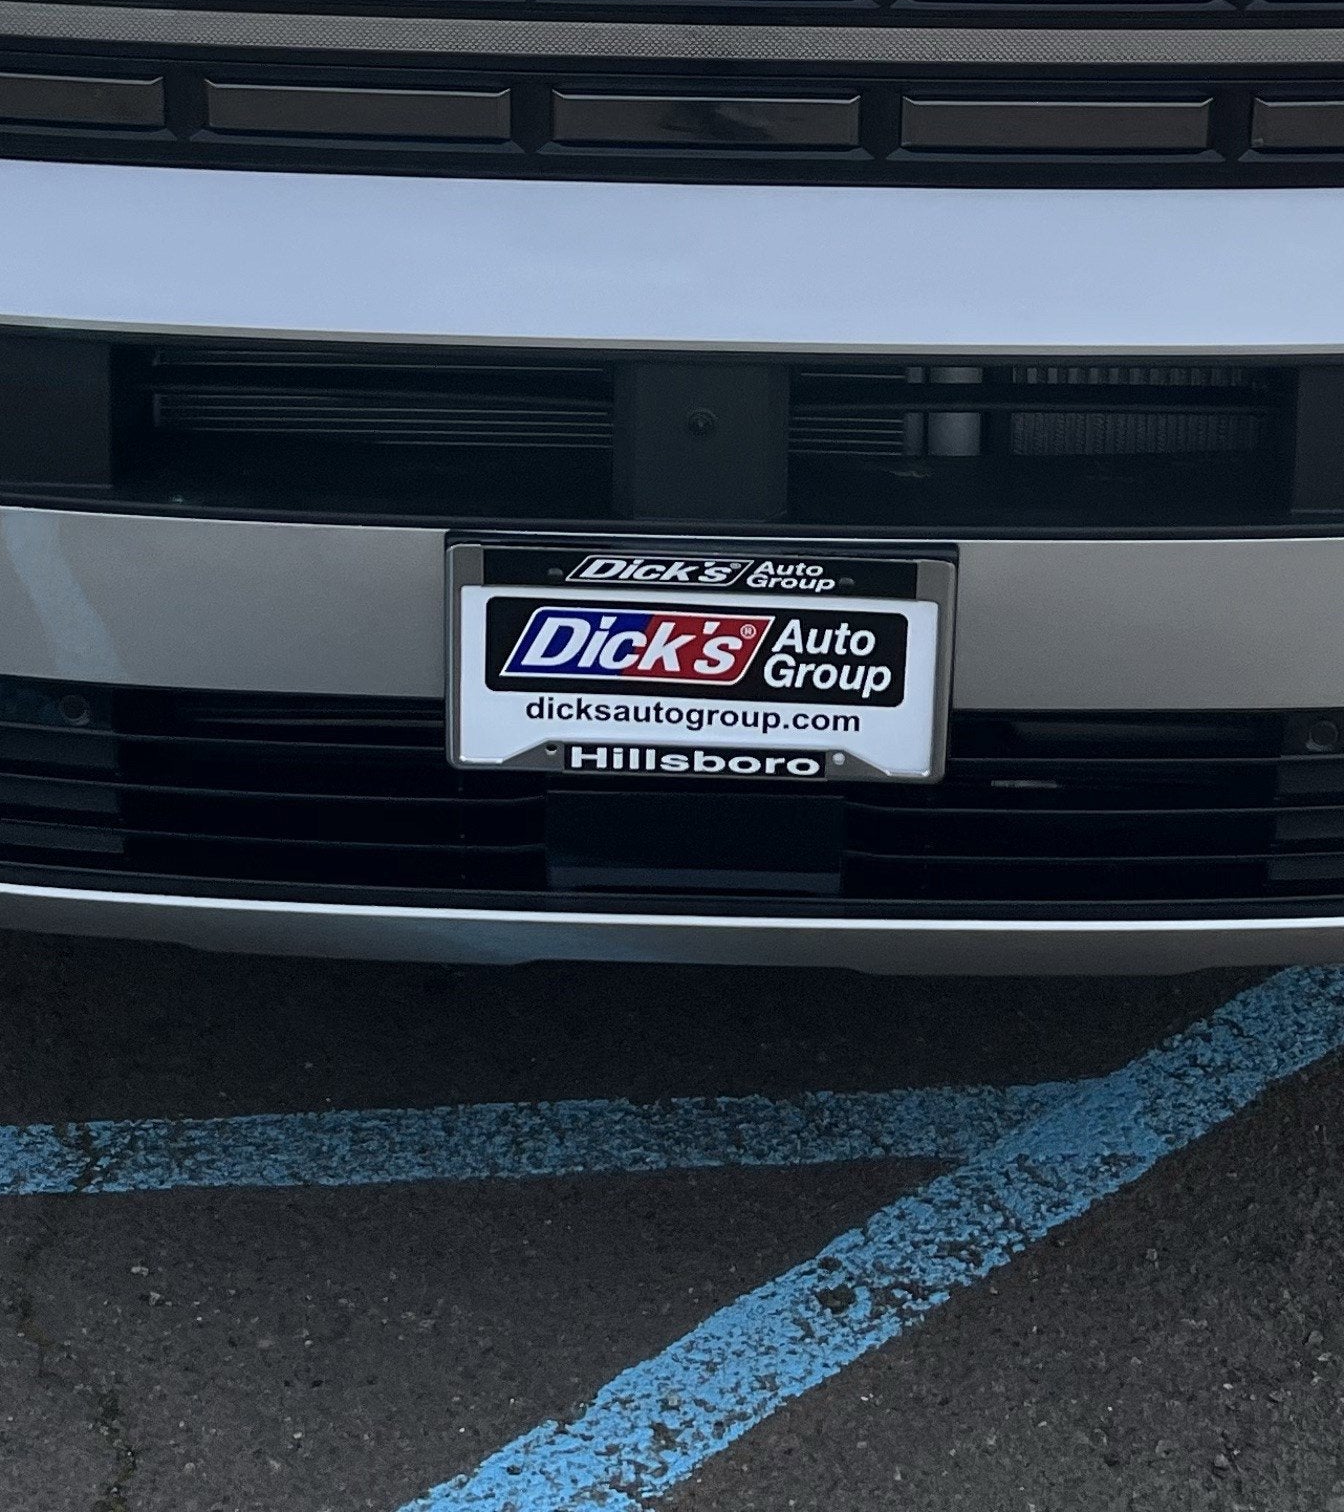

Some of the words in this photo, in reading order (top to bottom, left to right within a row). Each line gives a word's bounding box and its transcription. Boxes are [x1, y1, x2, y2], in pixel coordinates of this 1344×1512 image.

[579, 558, 733, 584] Dick's
[753, 560, 824, 577] Auto
[746, 573, 836, 593] Group
[520, 615, 743, 675] Dick's
[771, 618, 876, 656] Auto
[763, 652, 892, 699] Group
[525, 696, 861, 734] dicksautogroup.com
[570, 745, 821, 777] Hillsboro
